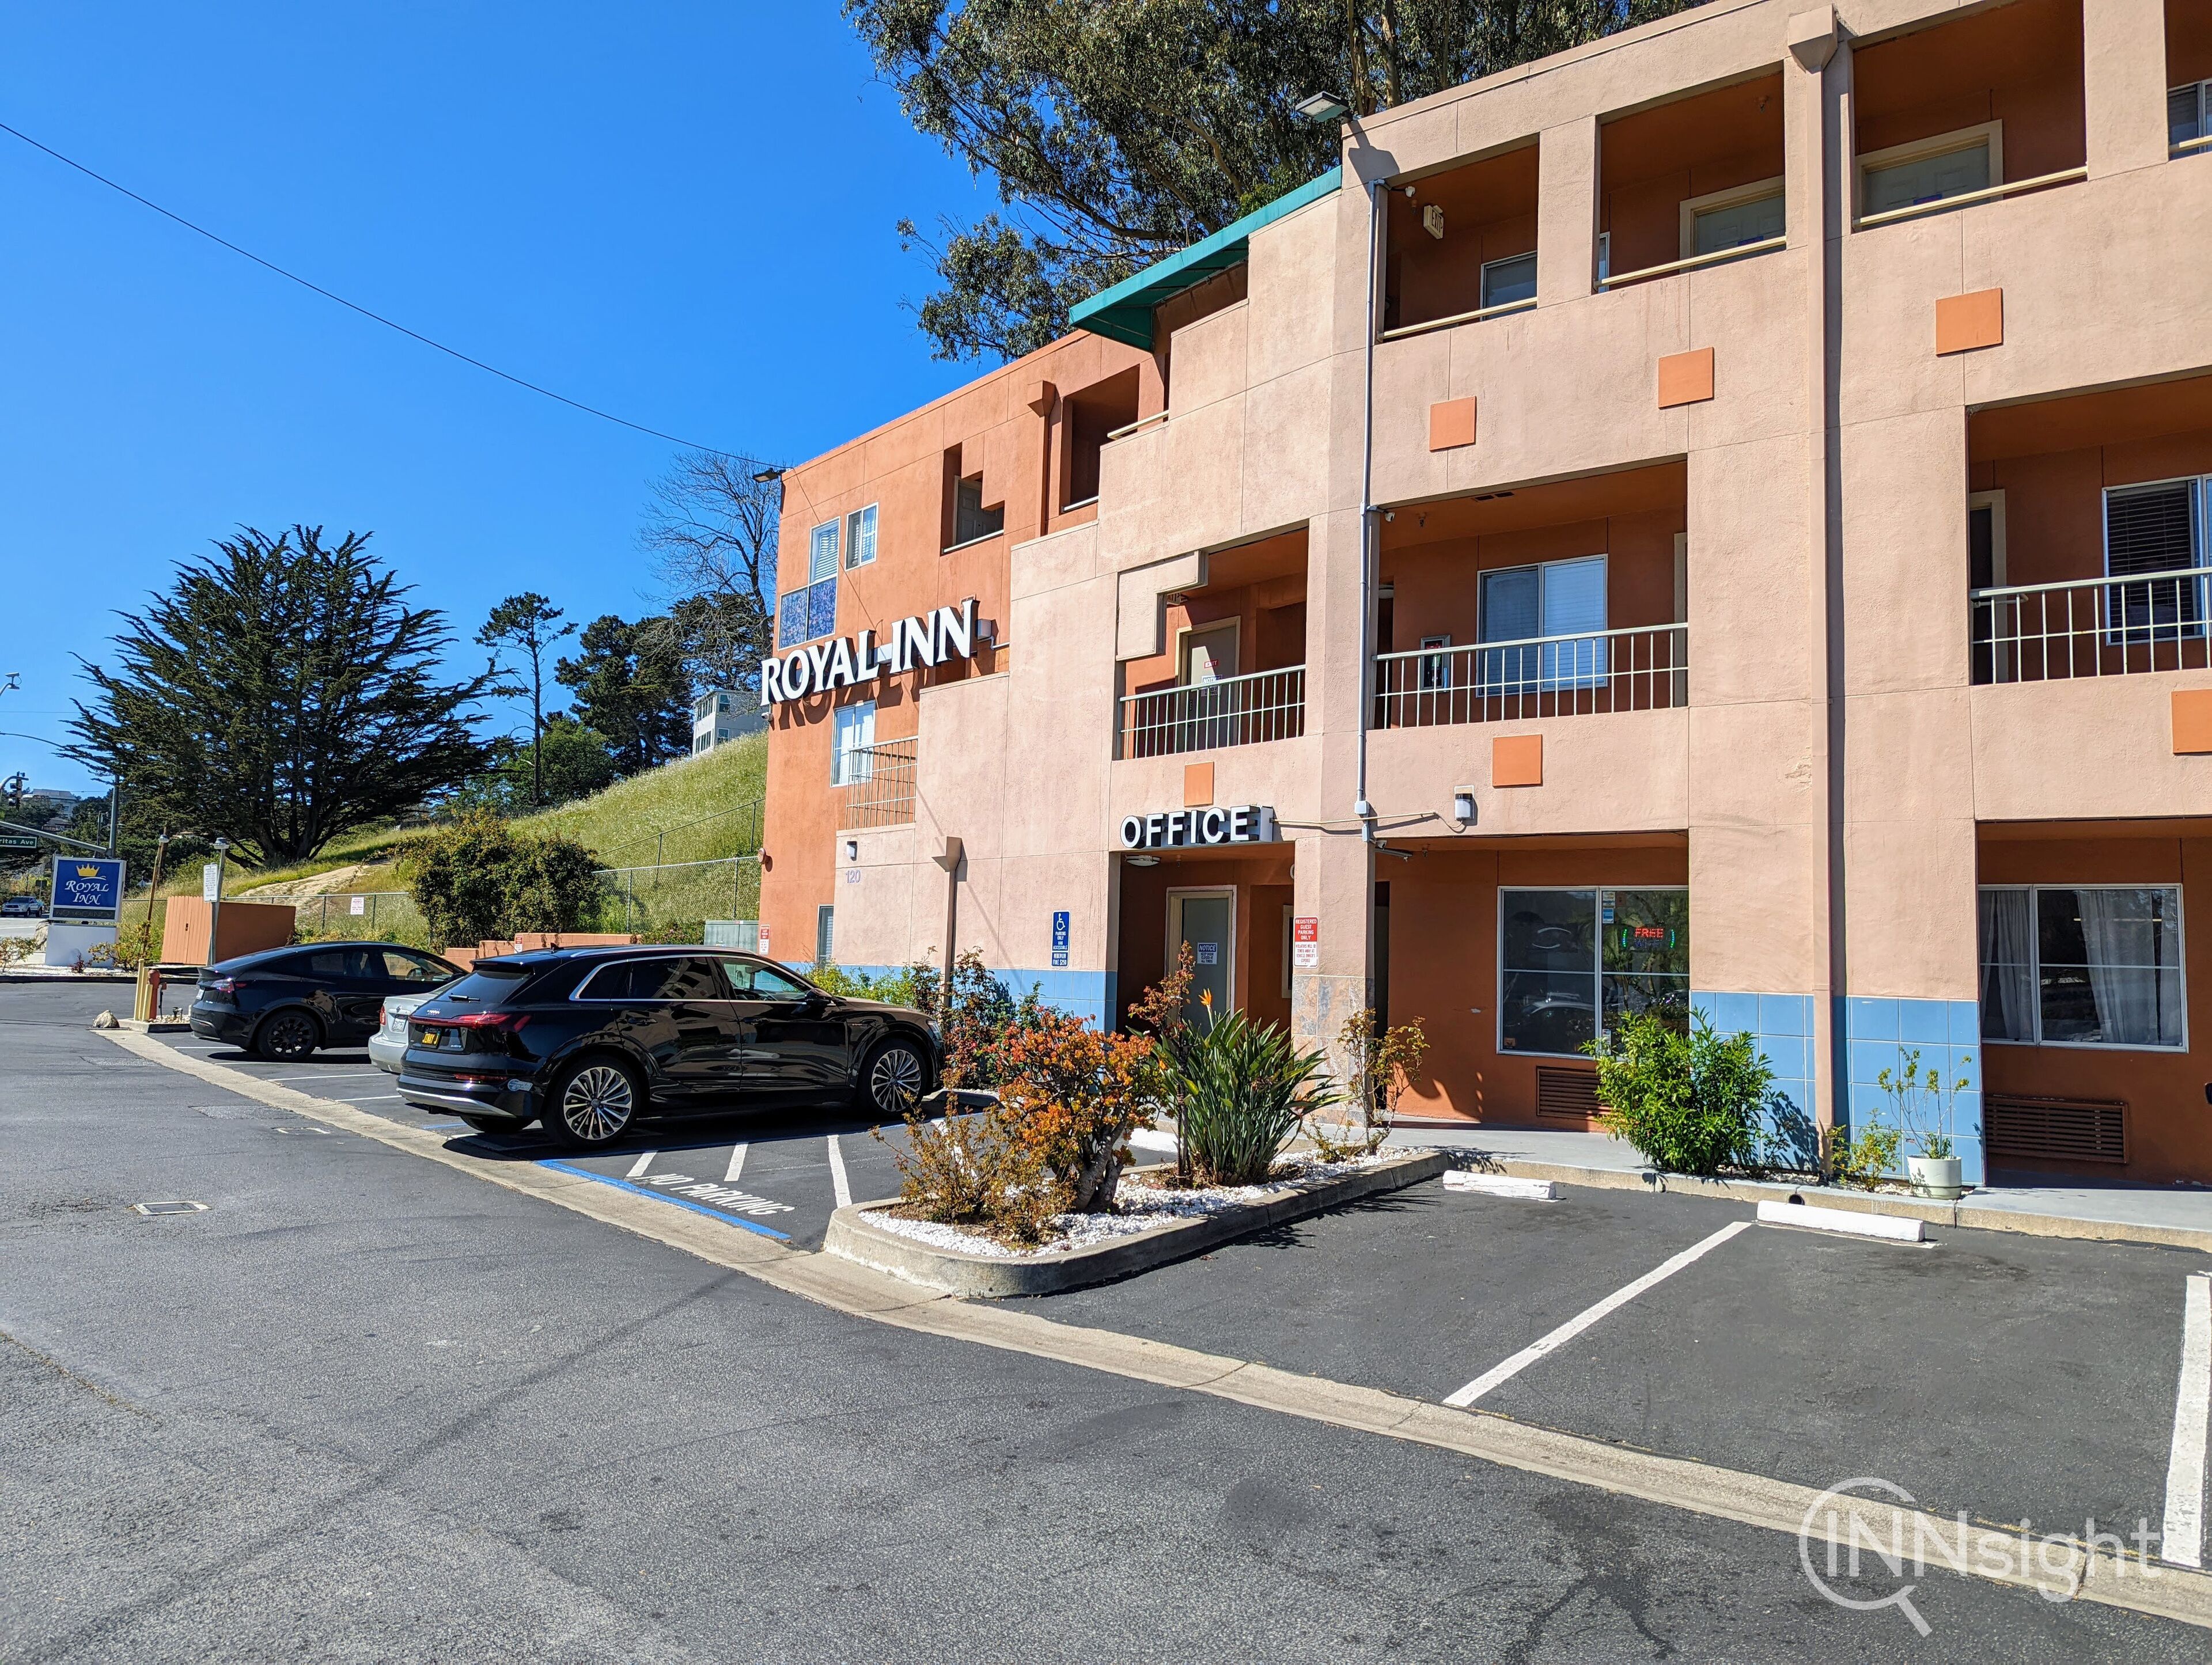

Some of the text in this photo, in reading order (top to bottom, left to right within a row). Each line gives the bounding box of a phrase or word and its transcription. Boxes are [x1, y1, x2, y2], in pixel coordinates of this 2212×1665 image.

[1431, 209, 1442, 233] EXIT
[760, 599, 974, 707] ROYAL INN
[1120, 806, 1251, 849] OFFICE
[846, 870, 861, 883] 120
[65, 880, 109, 893] ROYAL
[73, 893, 101, 905] INN
[1635, 928, 1664, 938] FREE
[634, 1173, 796, 1215] NO PARKING
